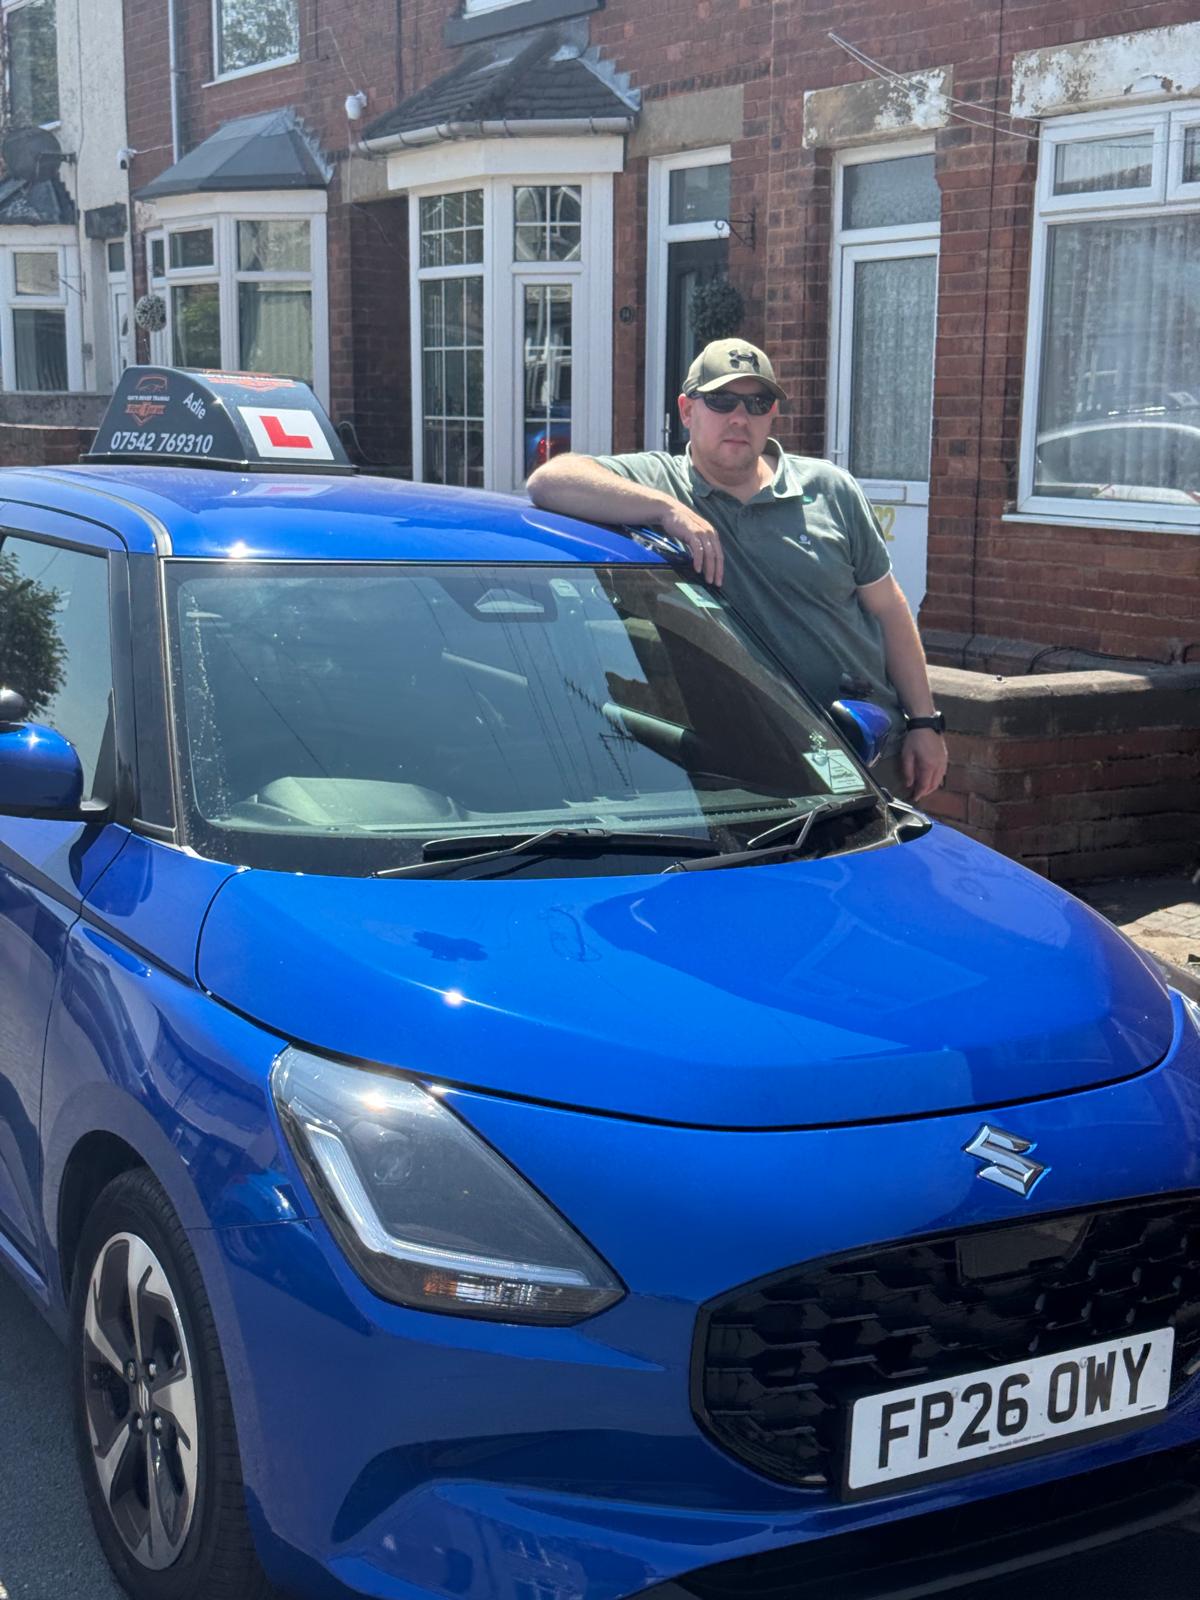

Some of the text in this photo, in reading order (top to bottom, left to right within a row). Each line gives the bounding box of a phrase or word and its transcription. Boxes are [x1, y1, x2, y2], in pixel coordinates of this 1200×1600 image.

[182, 392, 206, 420] Adie
[111, 431, 214, 454] 07542 769310
[259, 415, 313, 449] L
[878, 1342, 1152, 1469] FP26 OWY
